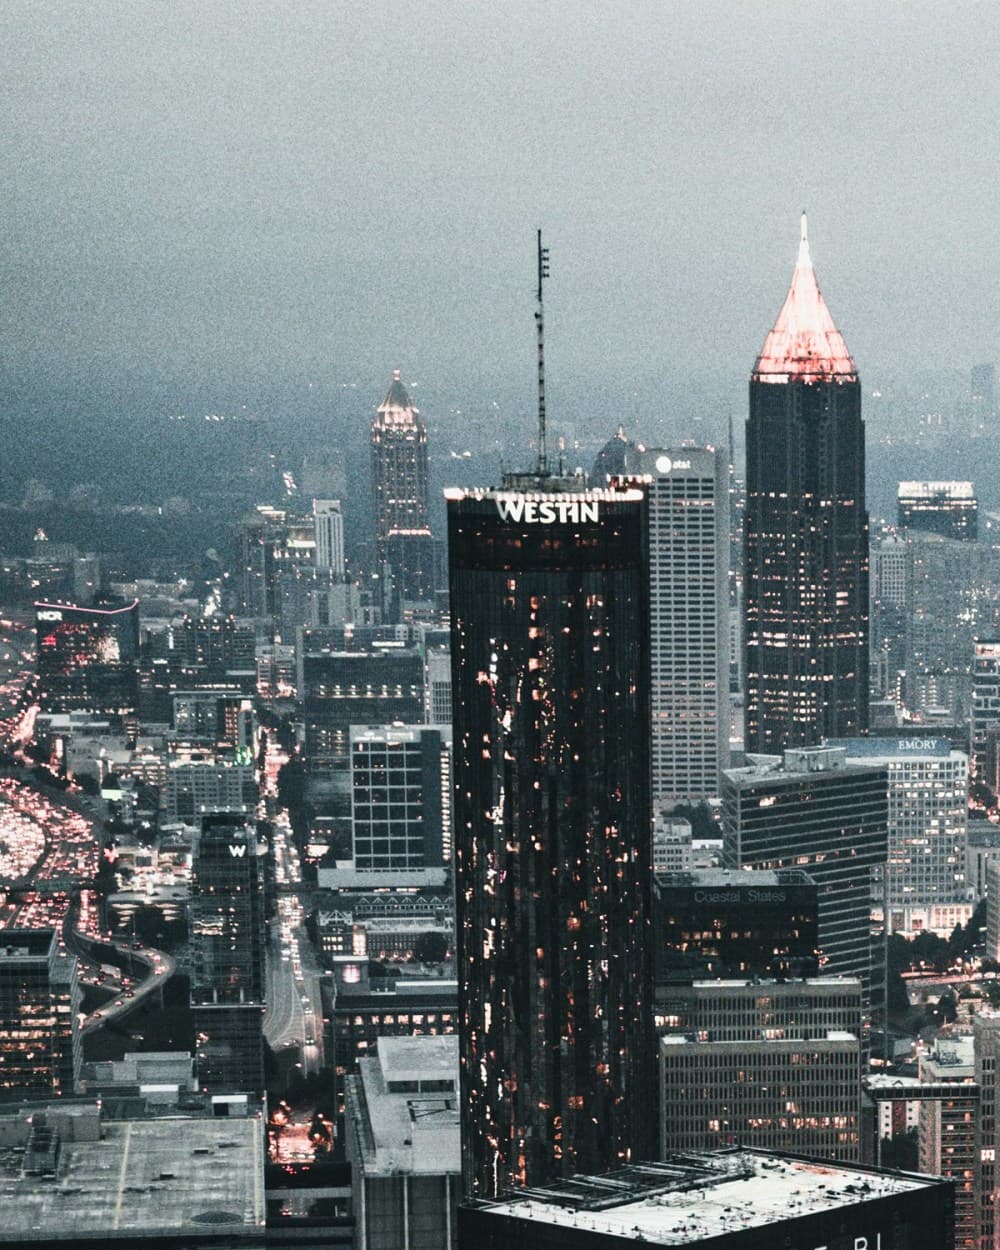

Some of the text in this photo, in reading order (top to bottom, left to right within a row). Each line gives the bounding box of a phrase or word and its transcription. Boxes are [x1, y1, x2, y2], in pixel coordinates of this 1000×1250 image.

[496, 499, 599, 523] WESTIN
[37, 610, 63, 621] NCR
[898, 739, 938, 750] EMORY
[228, 844, 246, 857] W
[694, 889, 786, 903] Coastal States
